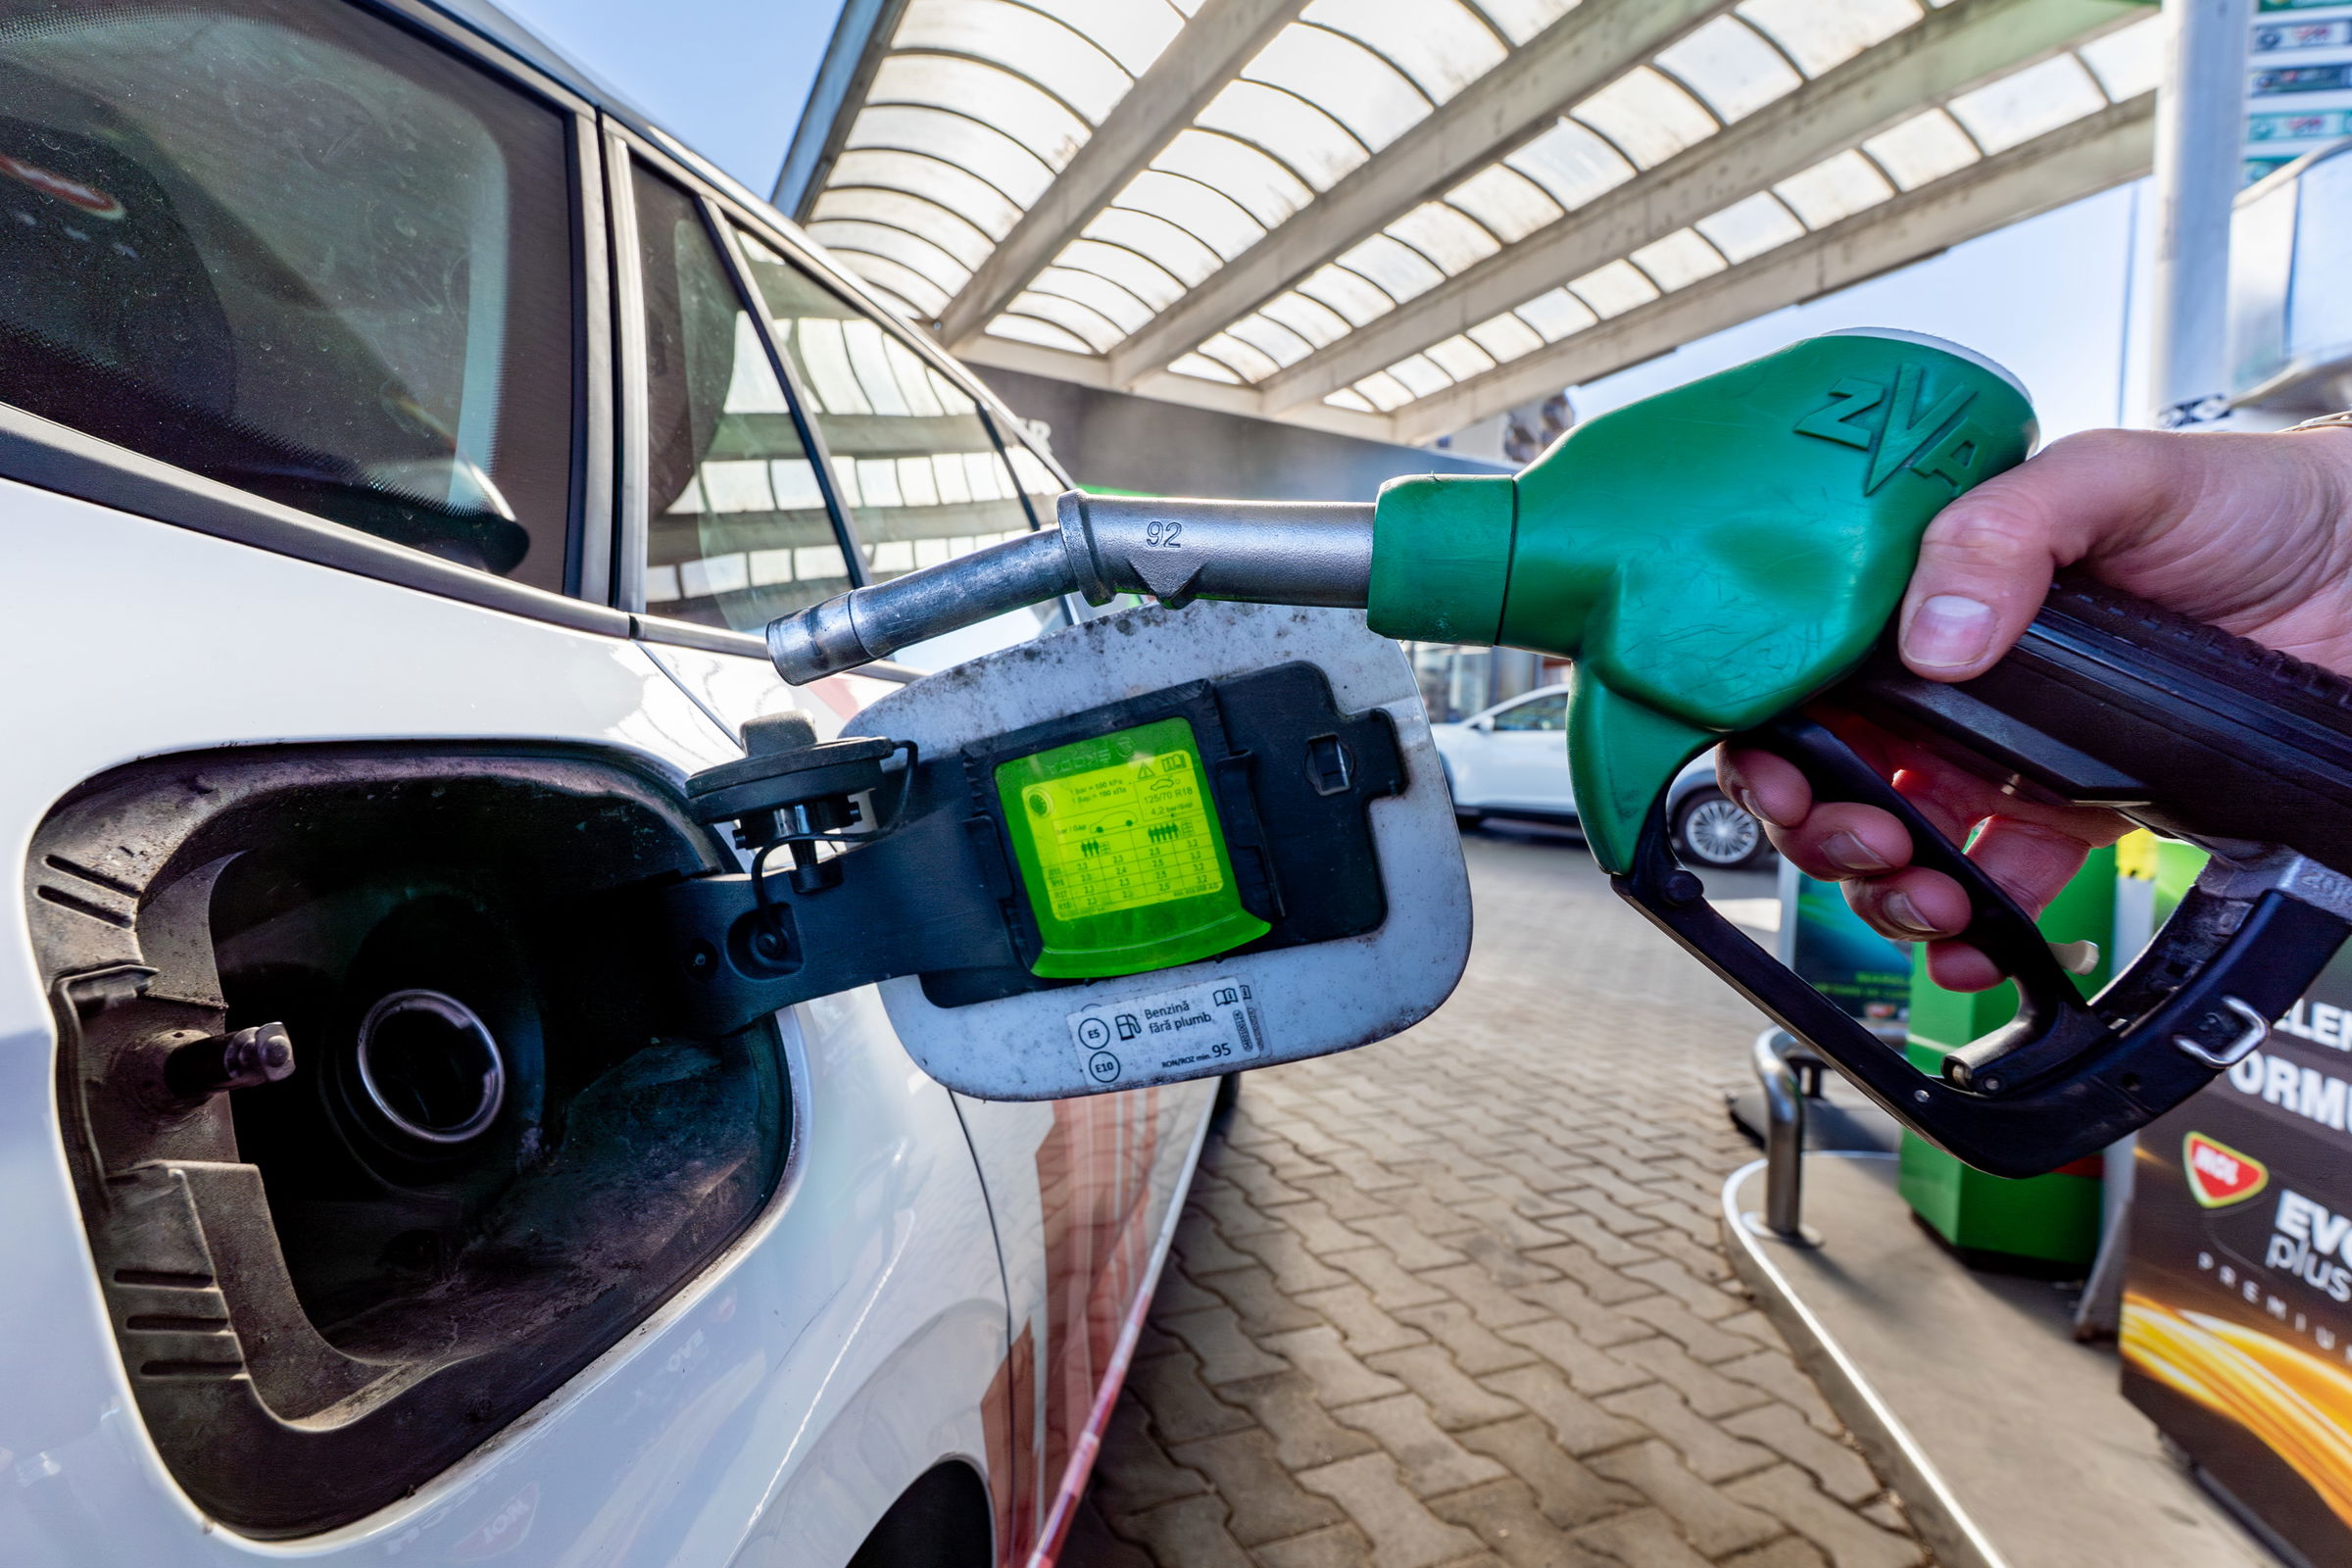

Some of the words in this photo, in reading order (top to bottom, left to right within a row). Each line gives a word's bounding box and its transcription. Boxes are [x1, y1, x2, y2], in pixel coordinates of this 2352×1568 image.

[1792, 364, 1992, 497] ZVA
[1147, 520, 1182, 548] 92
[1145, 791, 1173, 804] 125/70
[1175, 786, 1194, 797] R18
[1144, 1001, 1190, 1020] Benzină
[1149, 1019, 1172, 1034] fără
[1174, 1011, 1212, 1032] plumb
[1088, 1028, 1101, 1040] E5
[1211, 1043, 1232, 1057] 95
[1095, 1060, 1114, 1074] E10
[2266, 1233, 2352, 1302] plus
